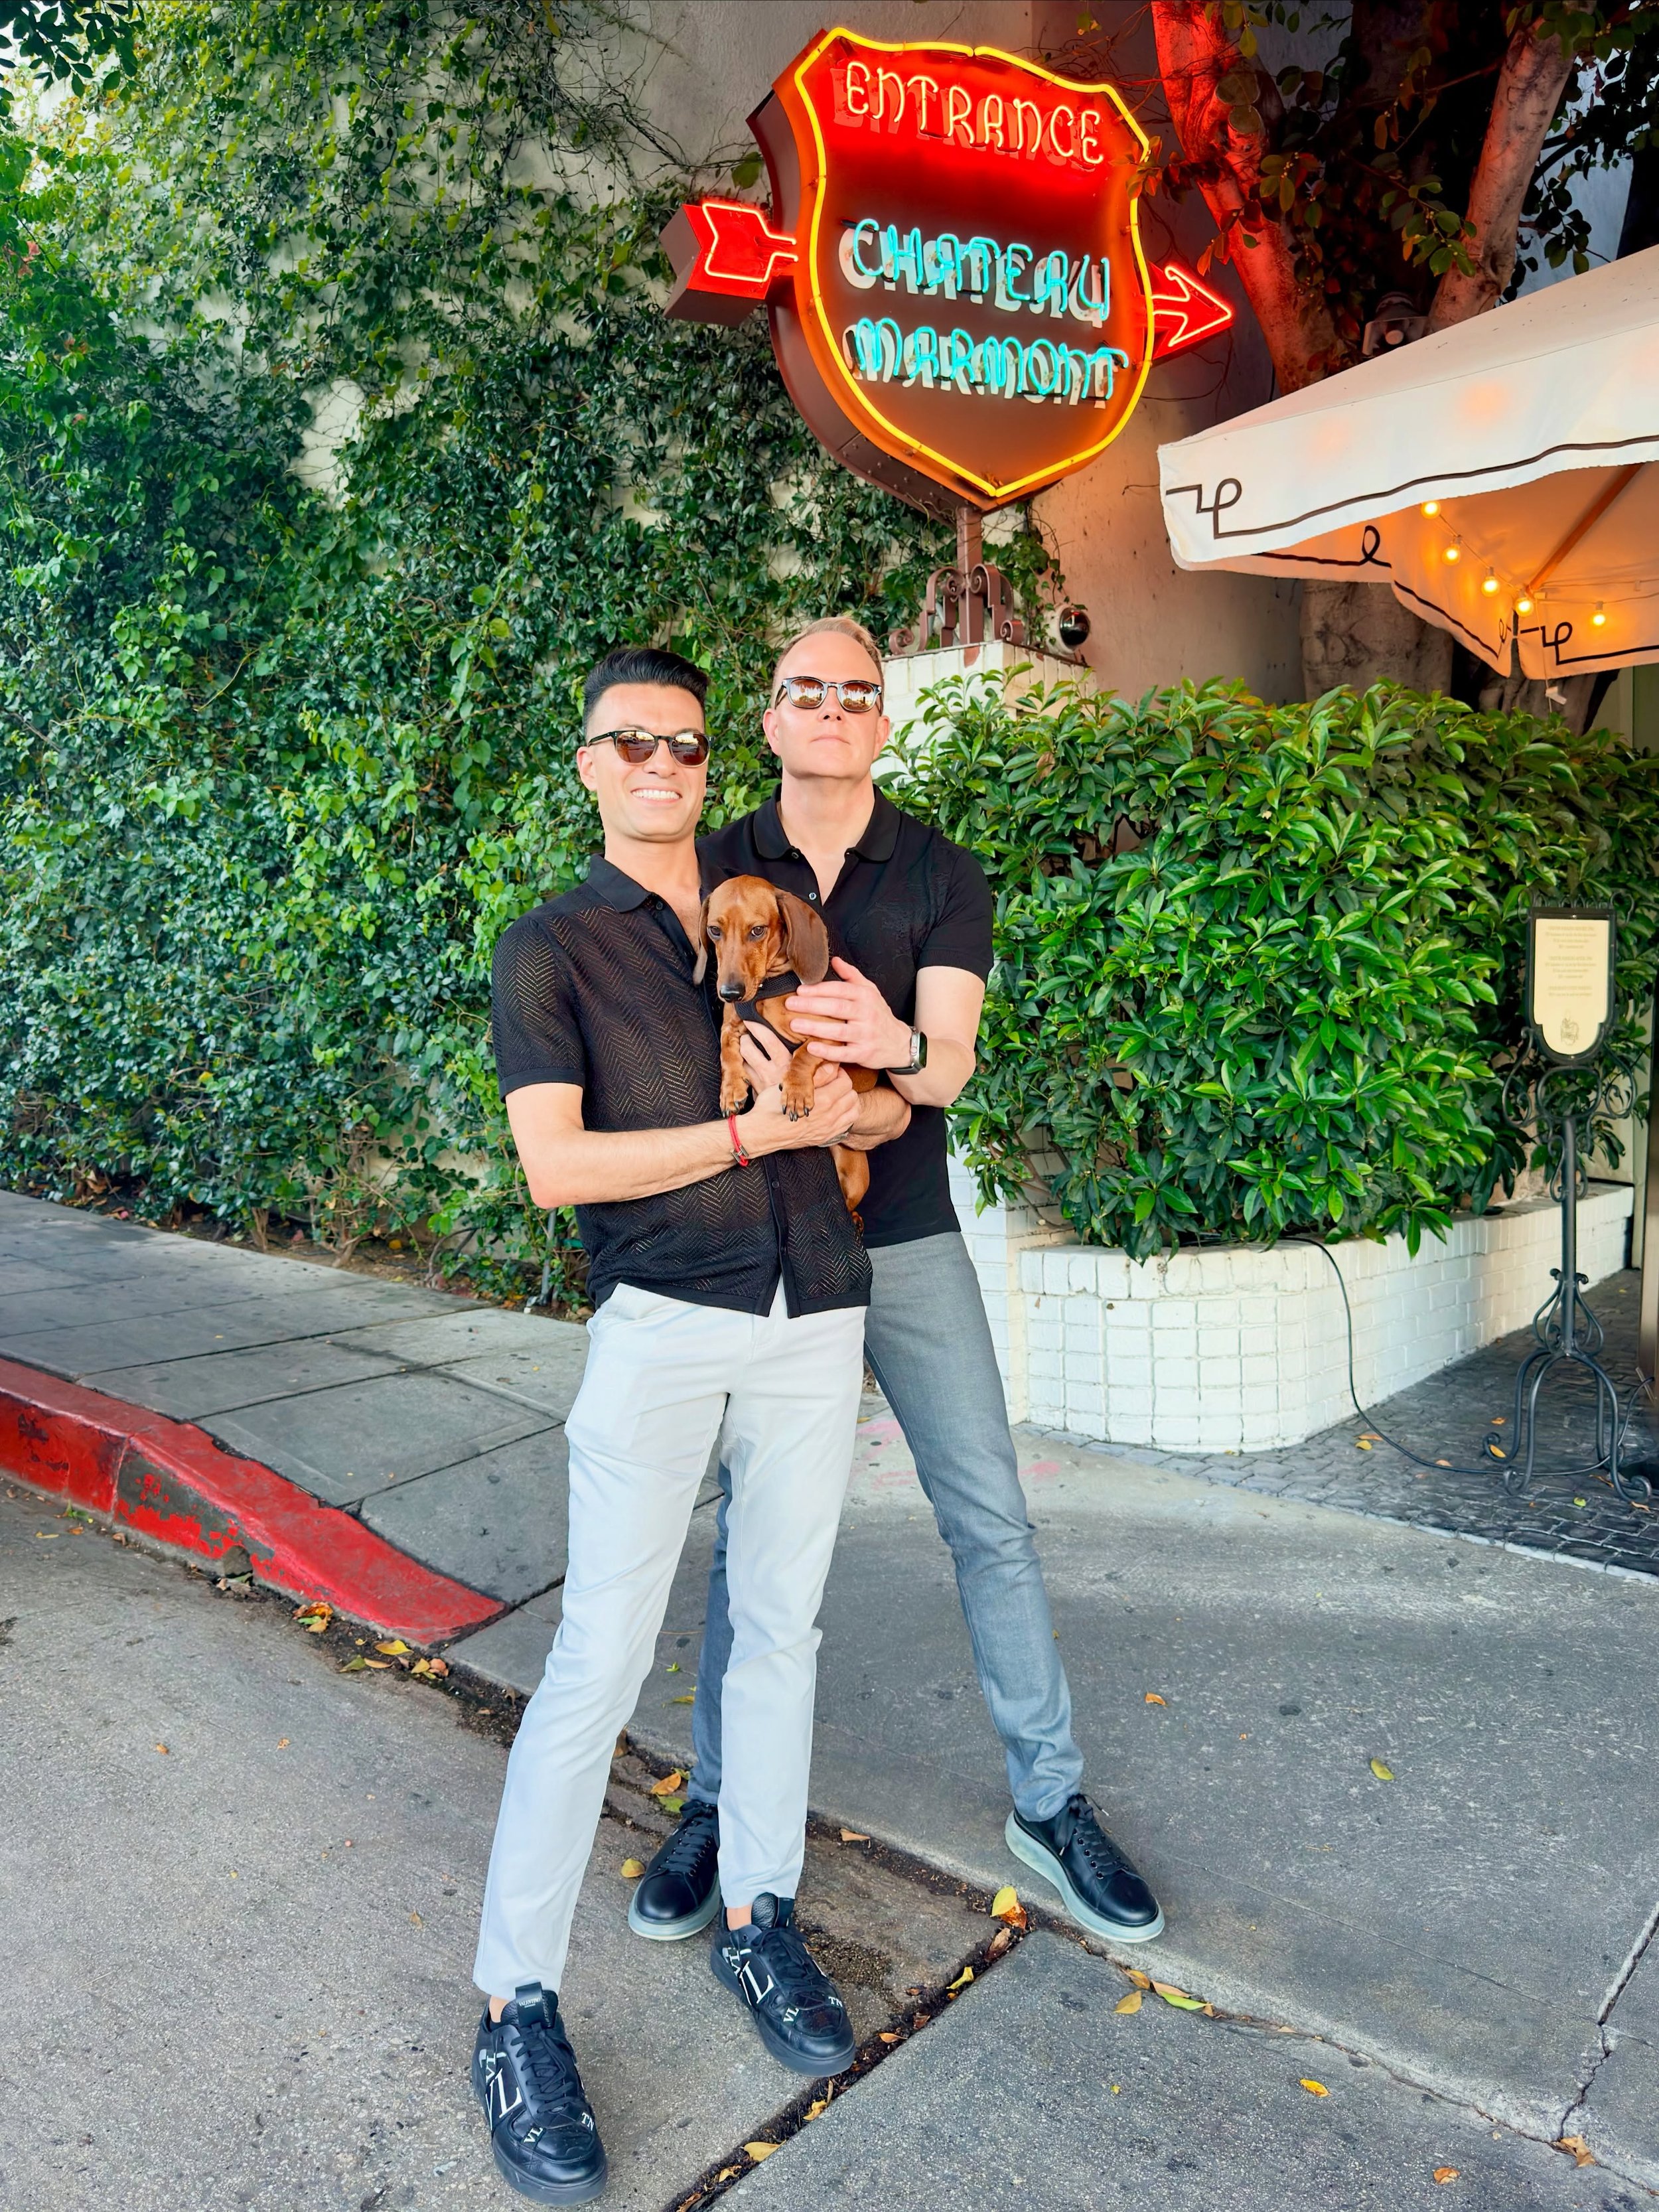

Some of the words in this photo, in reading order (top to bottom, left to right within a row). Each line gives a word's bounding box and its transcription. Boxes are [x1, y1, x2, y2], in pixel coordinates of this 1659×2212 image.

[832, 59, 1105, 171] ENTRANCE
[838, 218, 1112, 329] CHATEAU
[842, 317, 1129, 409] MARMONT
[828, 1996, 843, 2008] TN
[783, 2007, 800, 2022] VL
[581, 2112, 595, 2132] TN
[523, 2126, 543, 2144] VL
